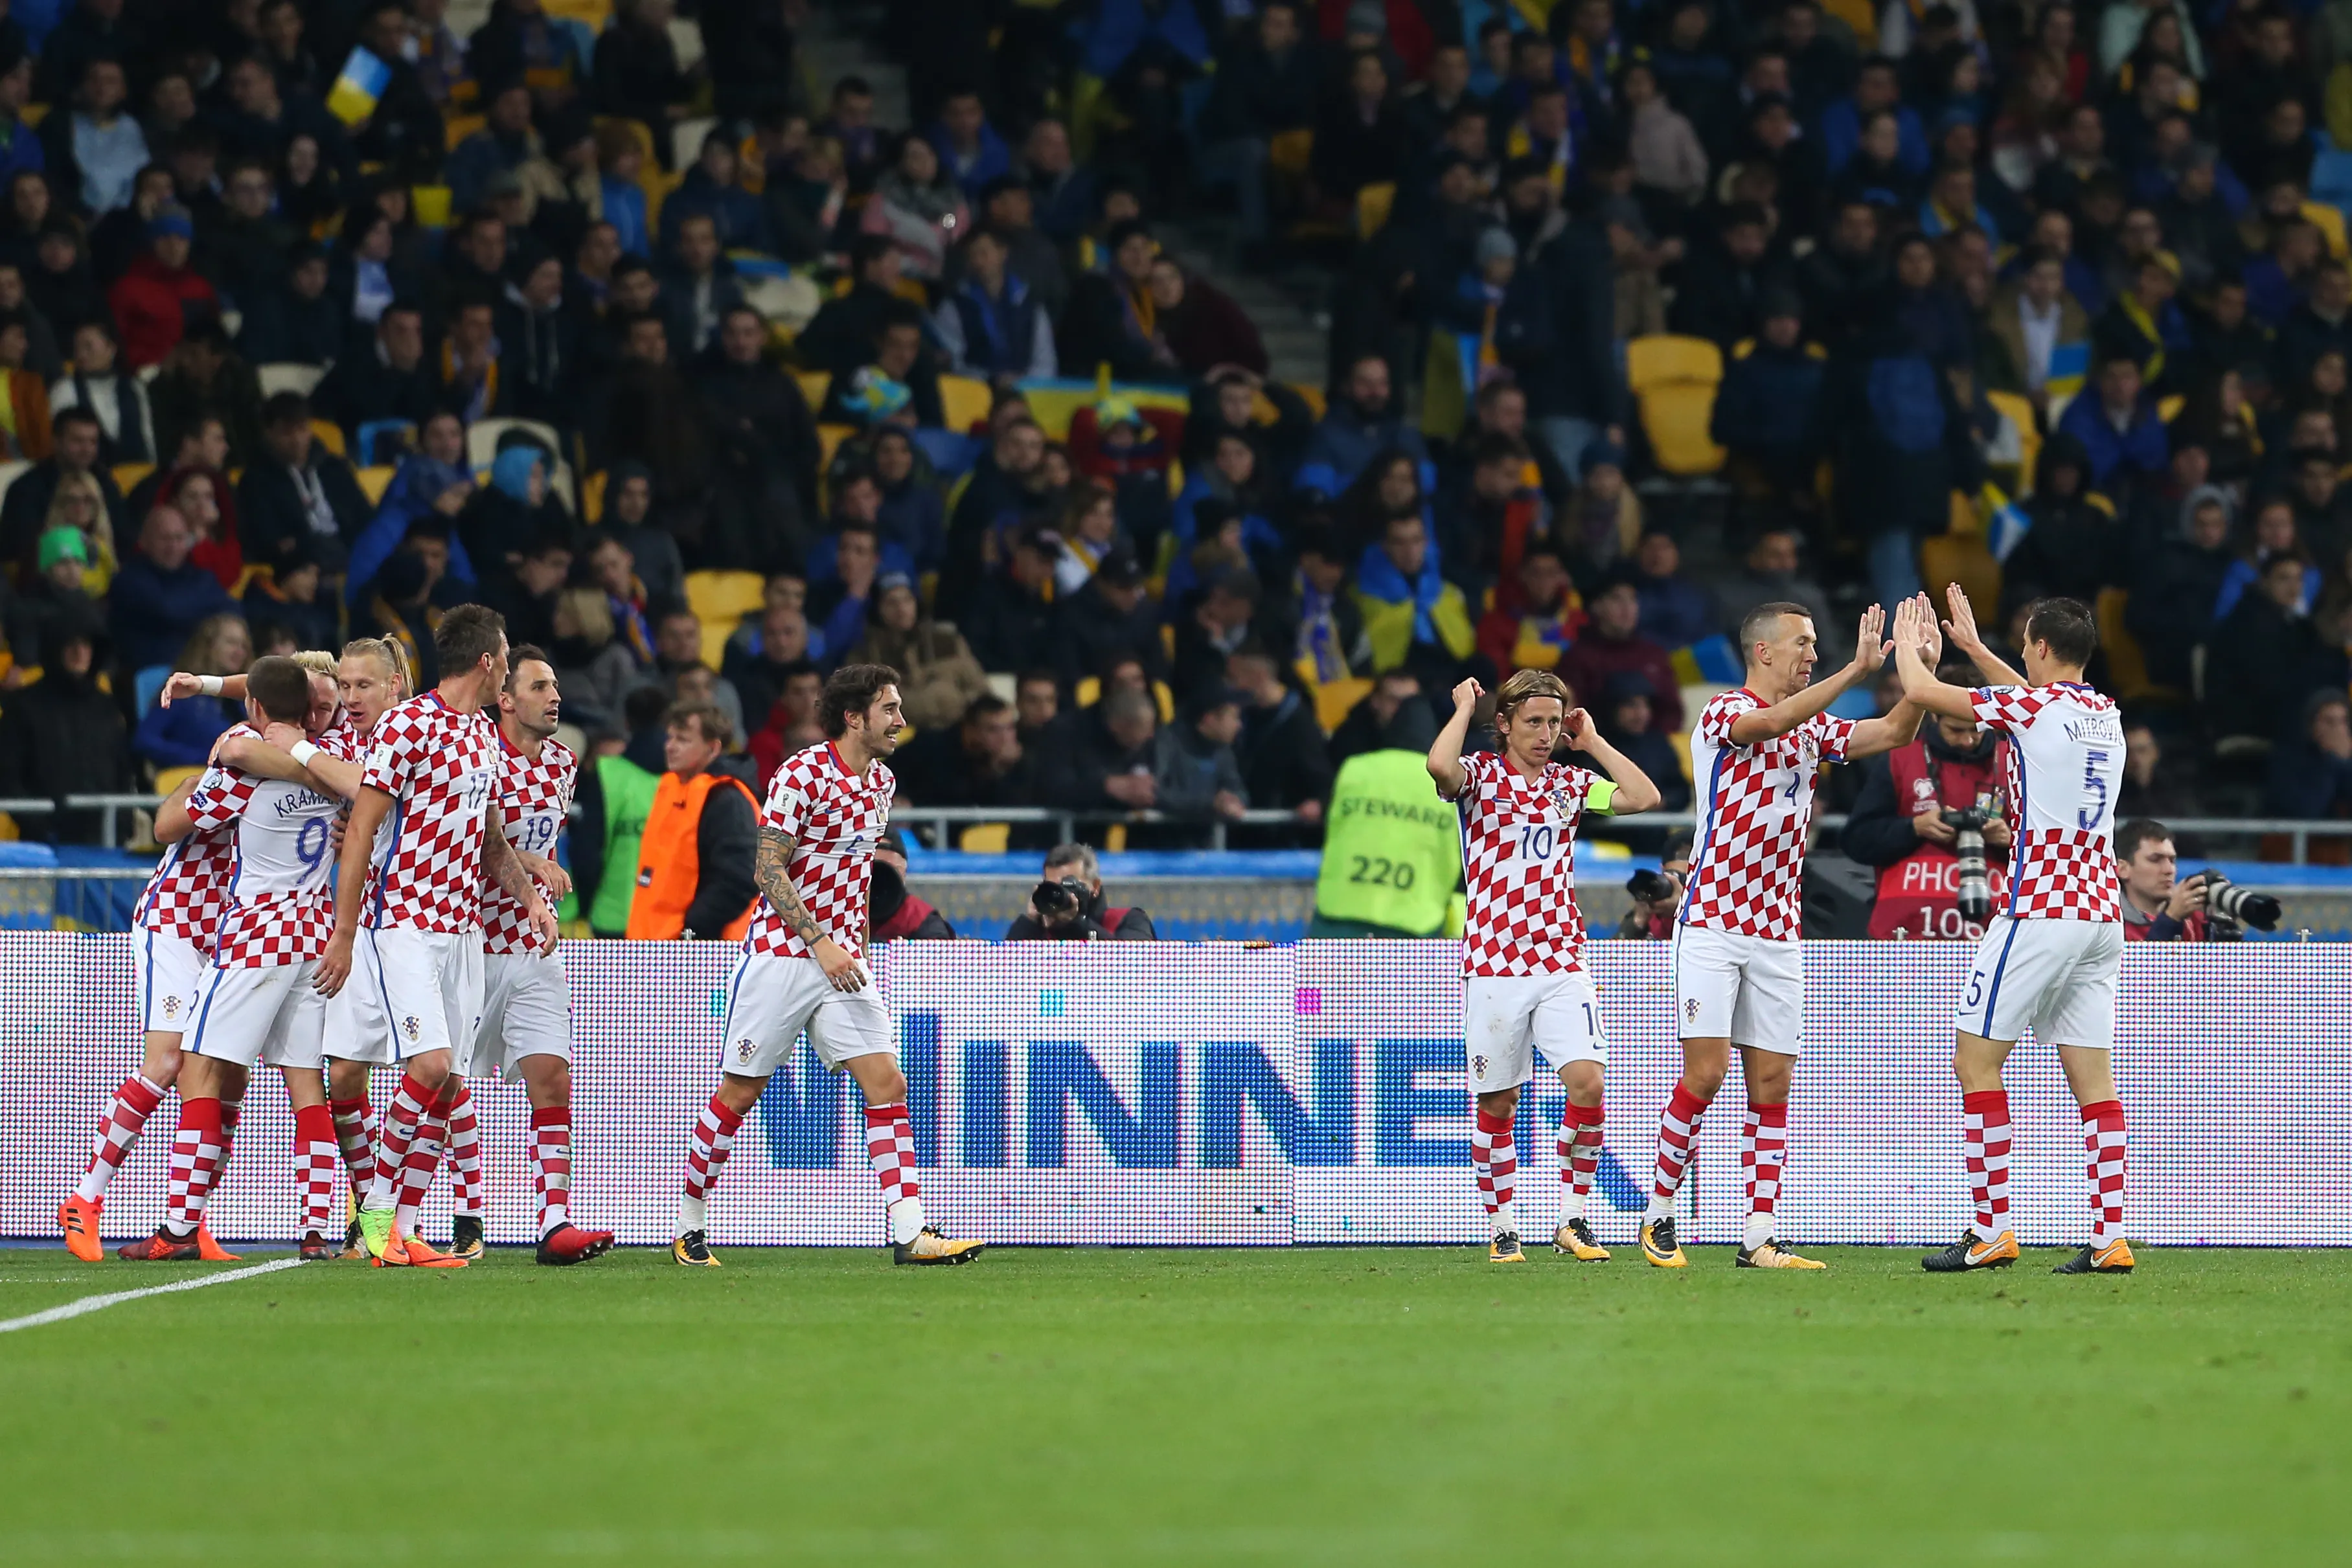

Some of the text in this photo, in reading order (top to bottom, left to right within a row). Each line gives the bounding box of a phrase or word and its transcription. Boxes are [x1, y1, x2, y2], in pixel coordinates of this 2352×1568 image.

[470, 773, 488, 810] 17
[1785, 772, 1800, 806] 4
[2077, 748, 2109, 831] 5
[1342, 797, 1454, 831] STEWARD
[524, 816, 554, 850] 19
[845, 835, 864, 854] 2
[1522, 825, 1553, 860] 10
[295, 816, 328, 887] 9
[1350, 854, 1415, 891] 220
[1902, 862, 2005, 897] PHOO
[1967, 970, 1985, 1006] 5
